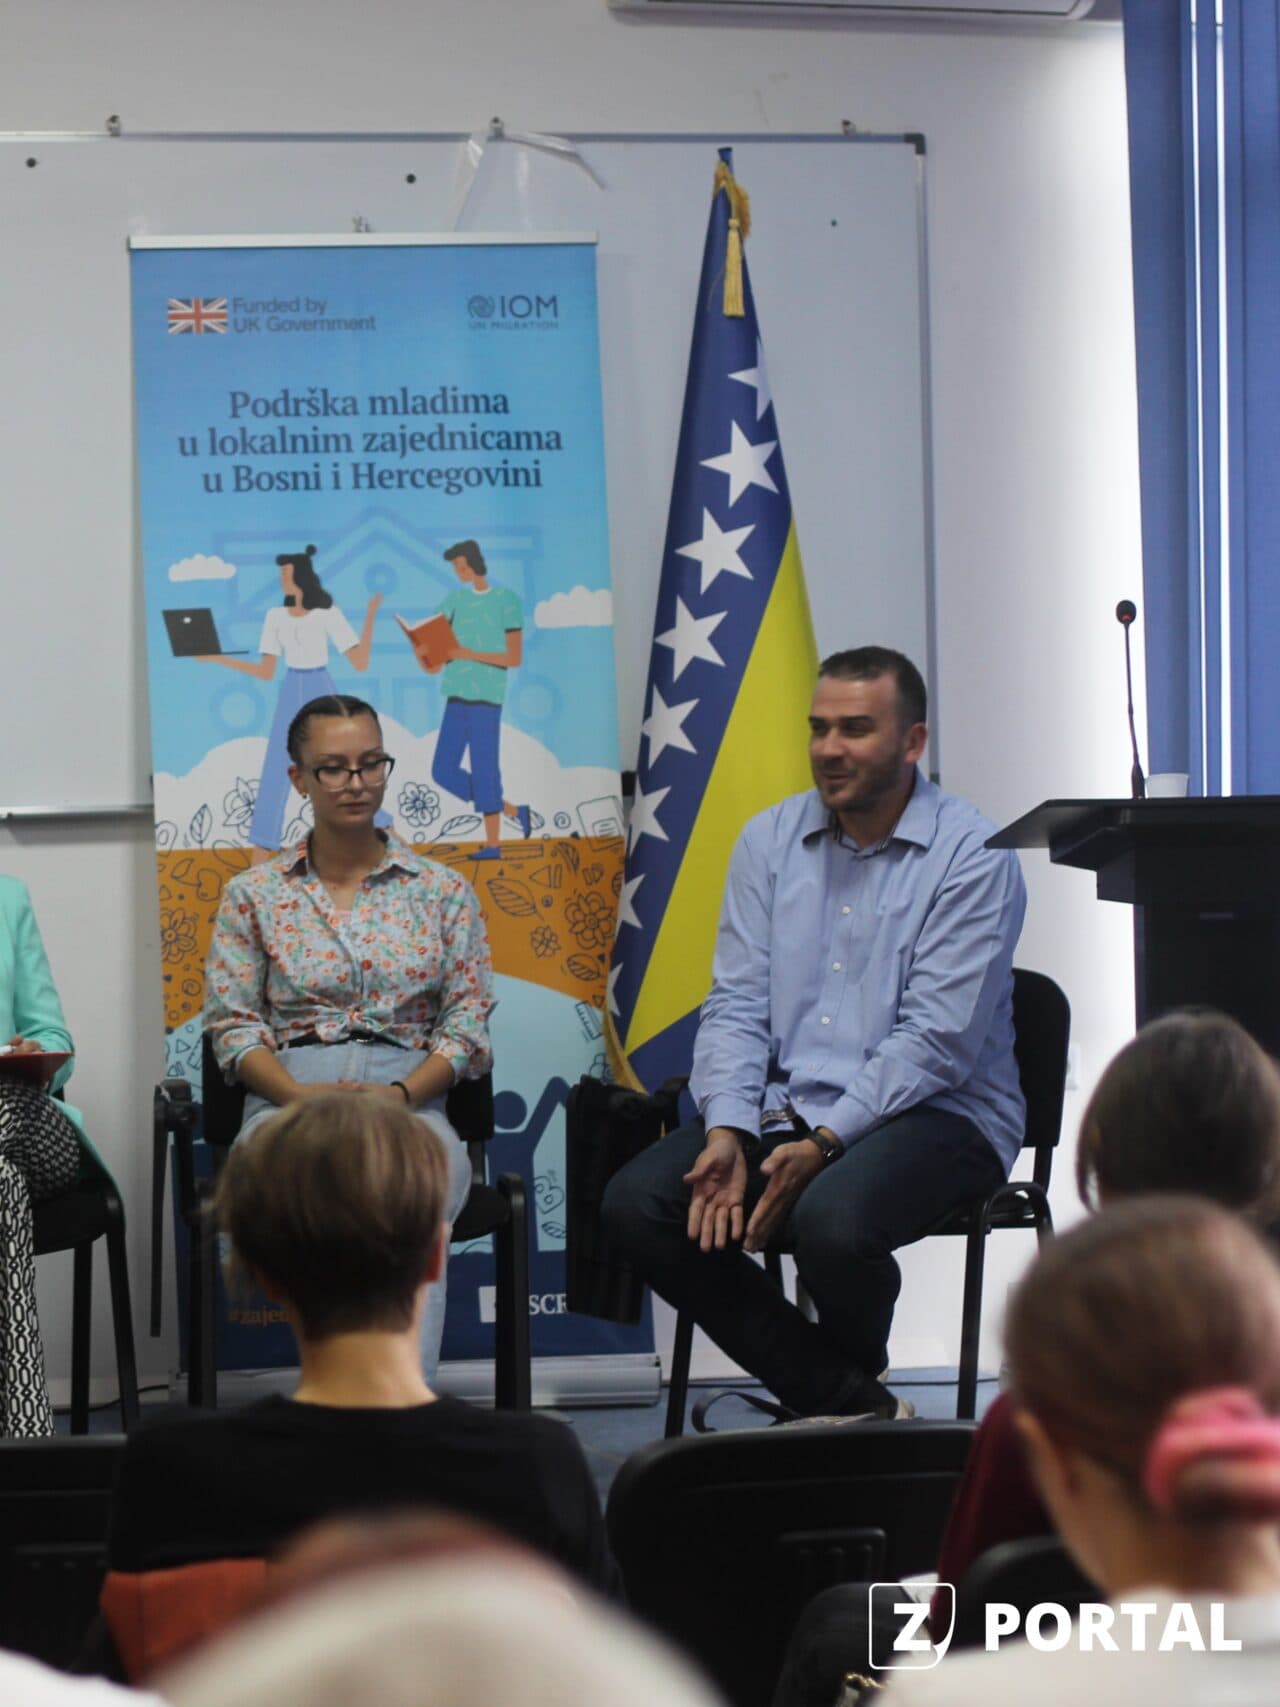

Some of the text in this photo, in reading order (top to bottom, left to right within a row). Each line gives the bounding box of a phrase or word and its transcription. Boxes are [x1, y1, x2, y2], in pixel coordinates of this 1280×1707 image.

[232, 296, 327, 315] Funded by
[500, 294, 558, 319] IOM
[232, 314, 376, 333] UK Government
[229, 386, 510, 419] Podrška mladima
[177, 422, 563, 459] u lokalnim zajednicama
[202, 459, 543, 496] u Bosni i Hercegovini
